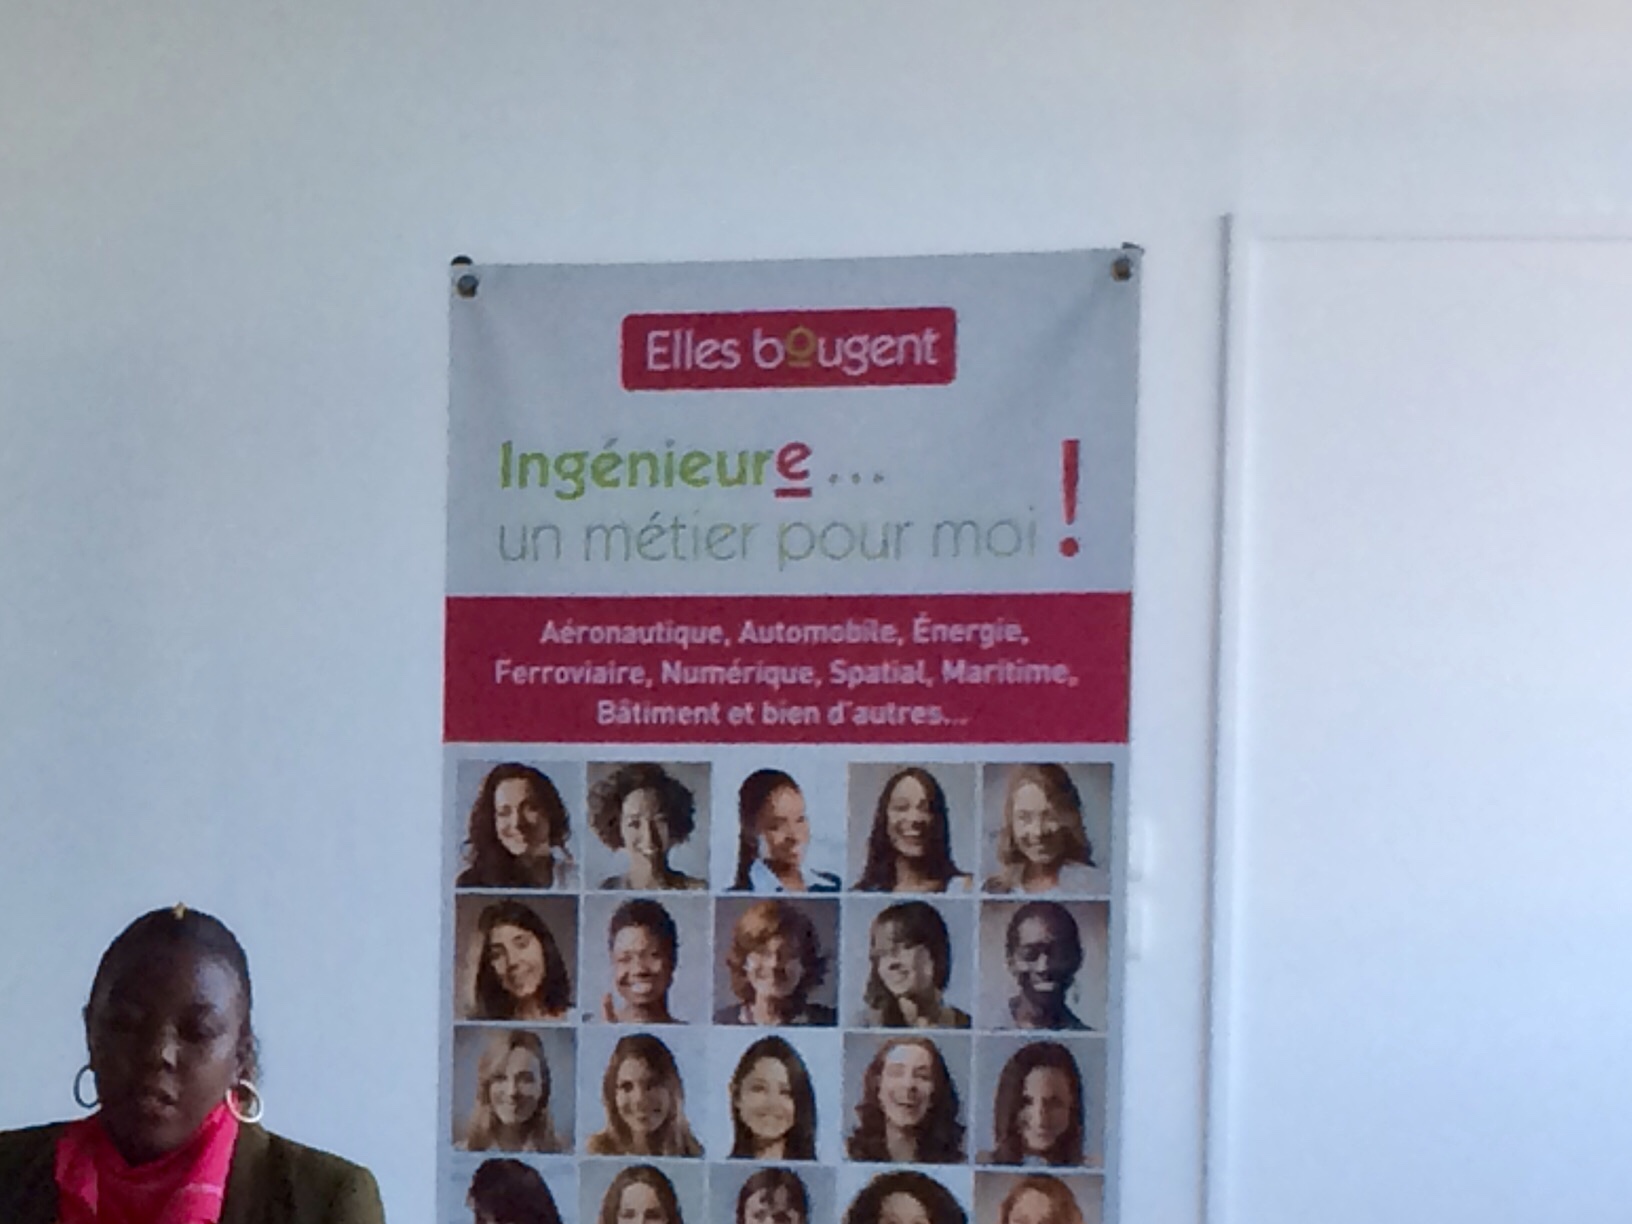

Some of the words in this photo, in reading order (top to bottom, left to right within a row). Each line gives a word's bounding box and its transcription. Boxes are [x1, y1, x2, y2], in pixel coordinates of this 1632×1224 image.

[647, 329, 741, 371] Elles
[754, 326, 939, 376] bougent
[499, 524, 561, 561] un
[585, 511, 759, 561] métier
[778, 520, 913, 571] pour
[933, 506, 1036, 559] moi
[540, 618, 730, 648] Aéronautique,
[738, 617, 904, 646] Automobile,
[913, 613, 1030, 648] Énergie,
[495, 659, 653, 688] Ferroviaire,
[662, 657, 822, 690] Numérique,
[829, 658, 934, 688] Spatial,
[942, 657, 1080, 686] Maritime,
[597, 698, 721, 726] Bâtiment
[728, 702, 756, 725] et
[763, 697, 820, 725] bien
